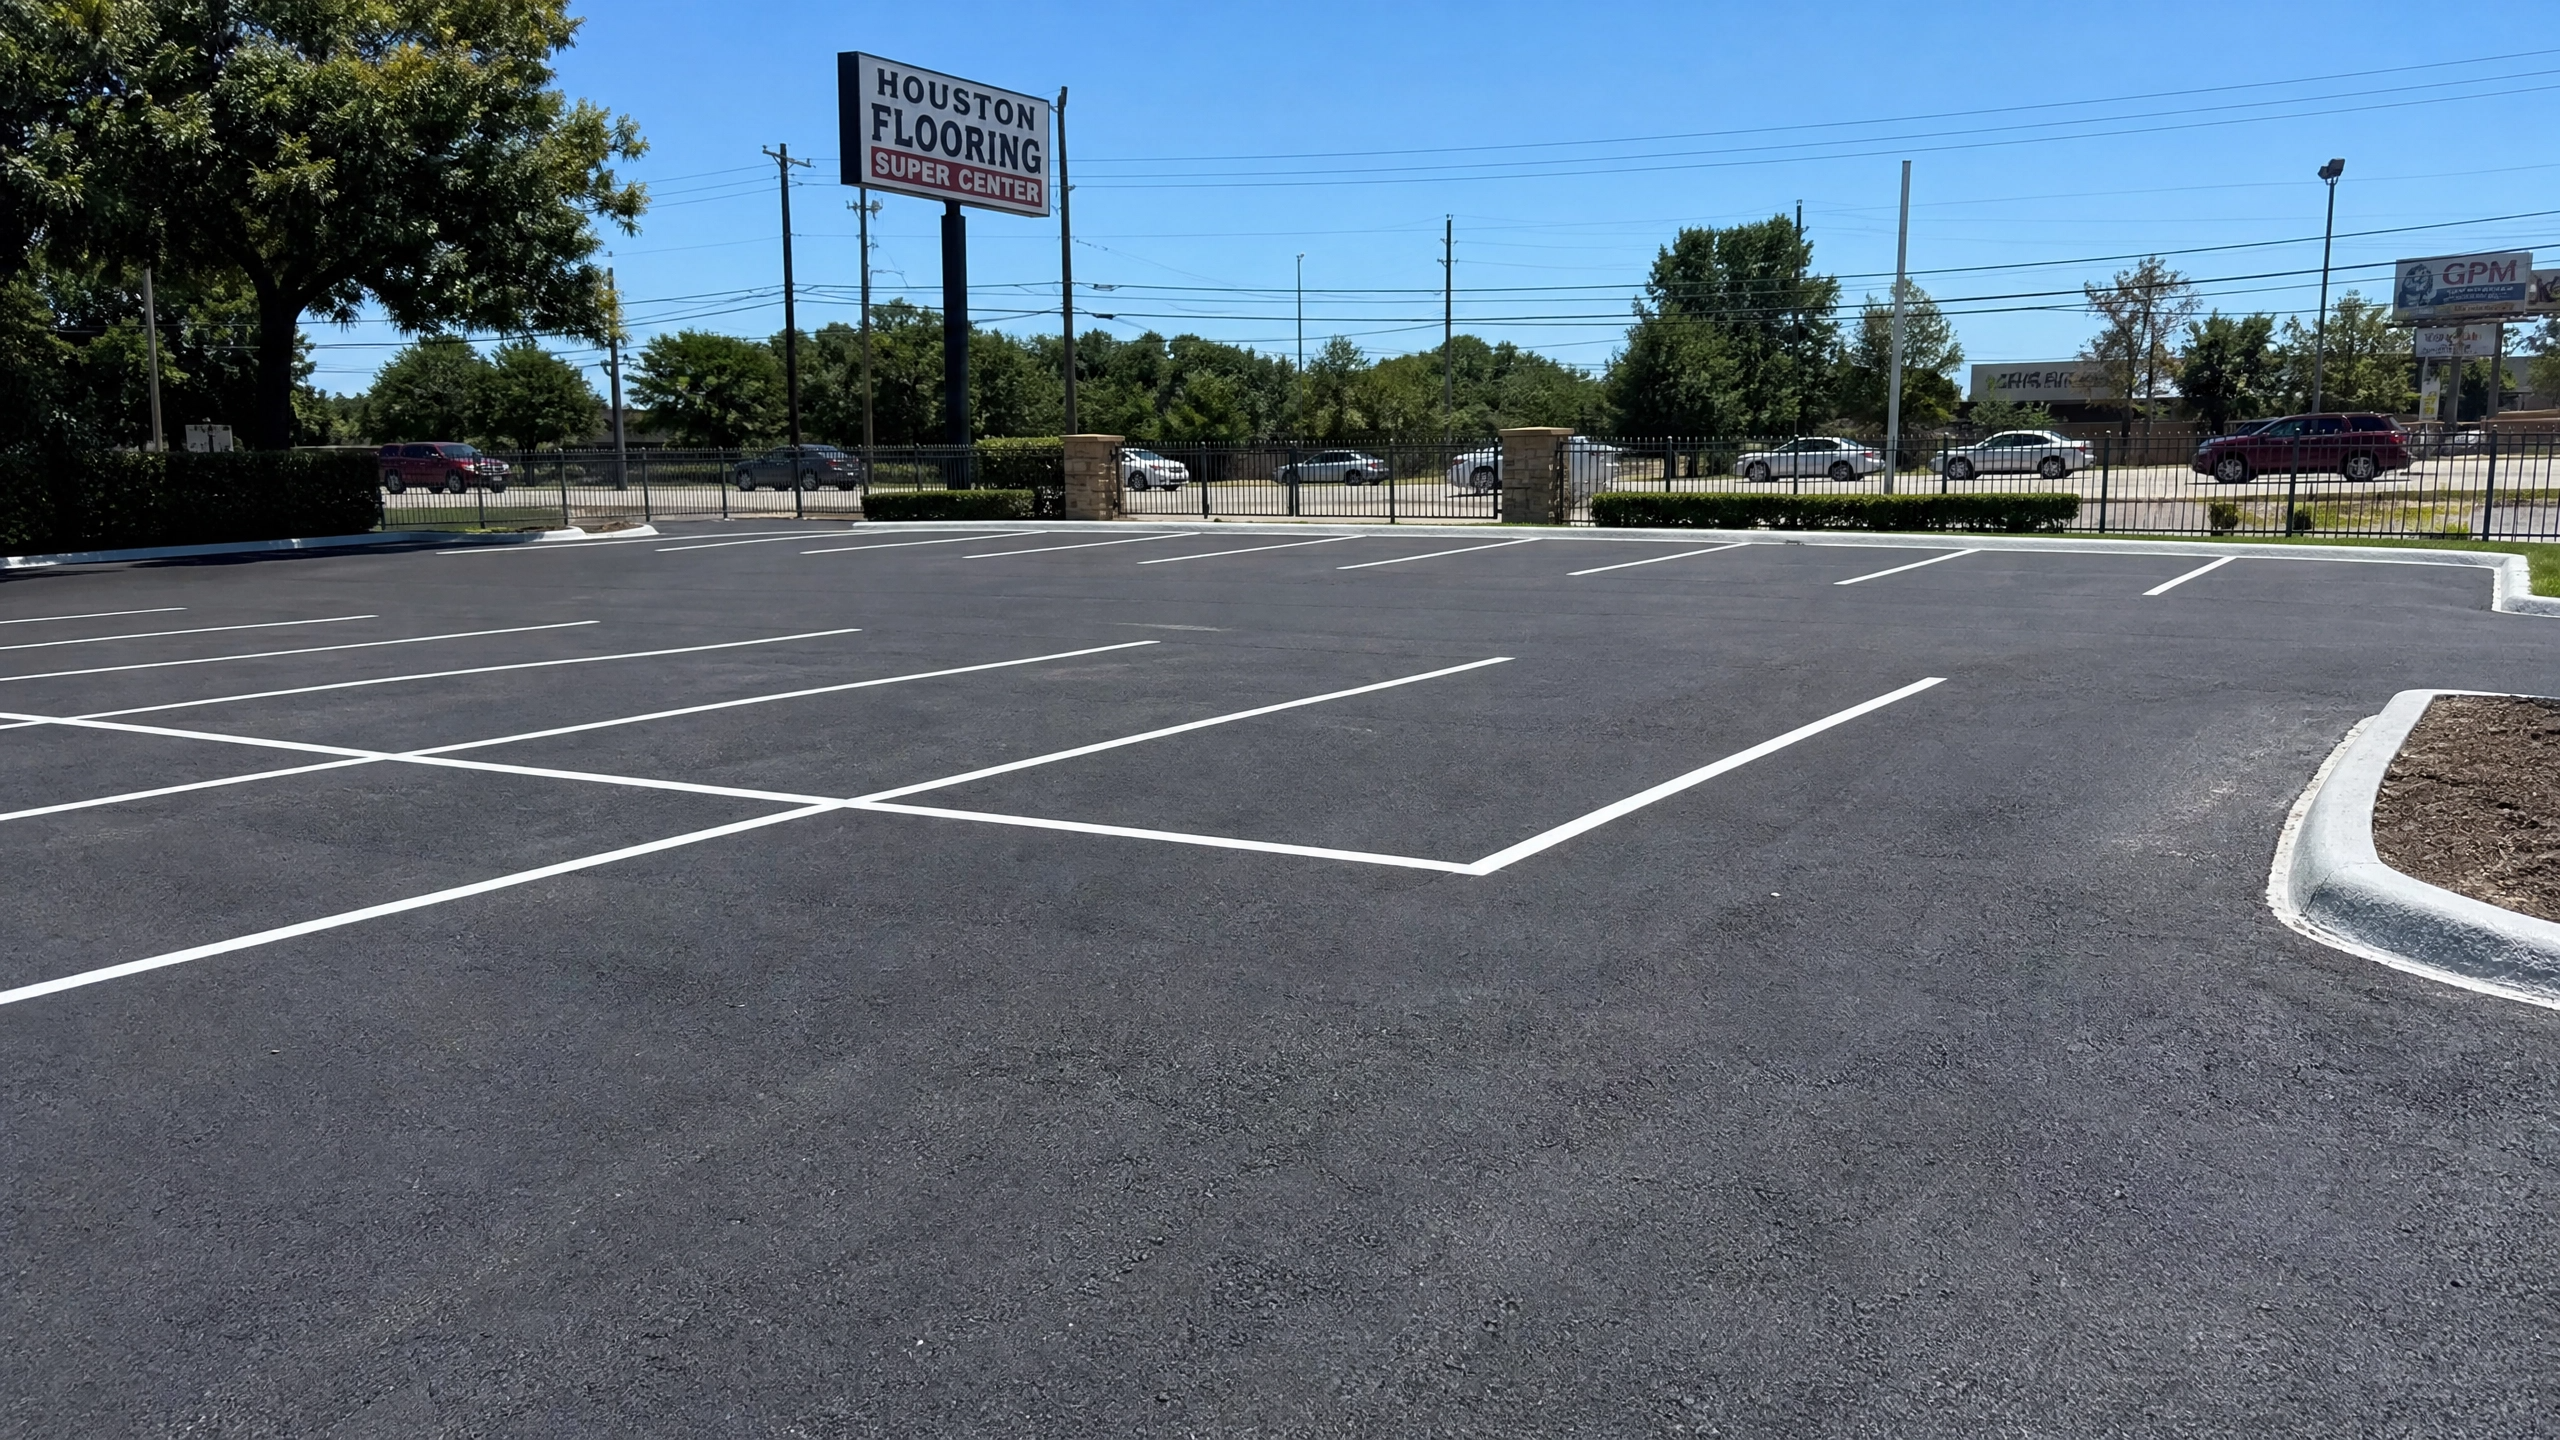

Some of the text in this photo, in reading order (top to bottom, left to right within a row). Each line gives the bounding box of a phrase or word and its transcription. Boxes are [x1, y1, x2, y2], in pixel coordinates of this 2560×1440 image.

[877, 68, 1035, 131] HOUSTON
[871, 102, 1042, 174] FLOORING
[875, 151, 1040, 203] SUPER CENTER
[2442, 259, 2517, 285] GPM
